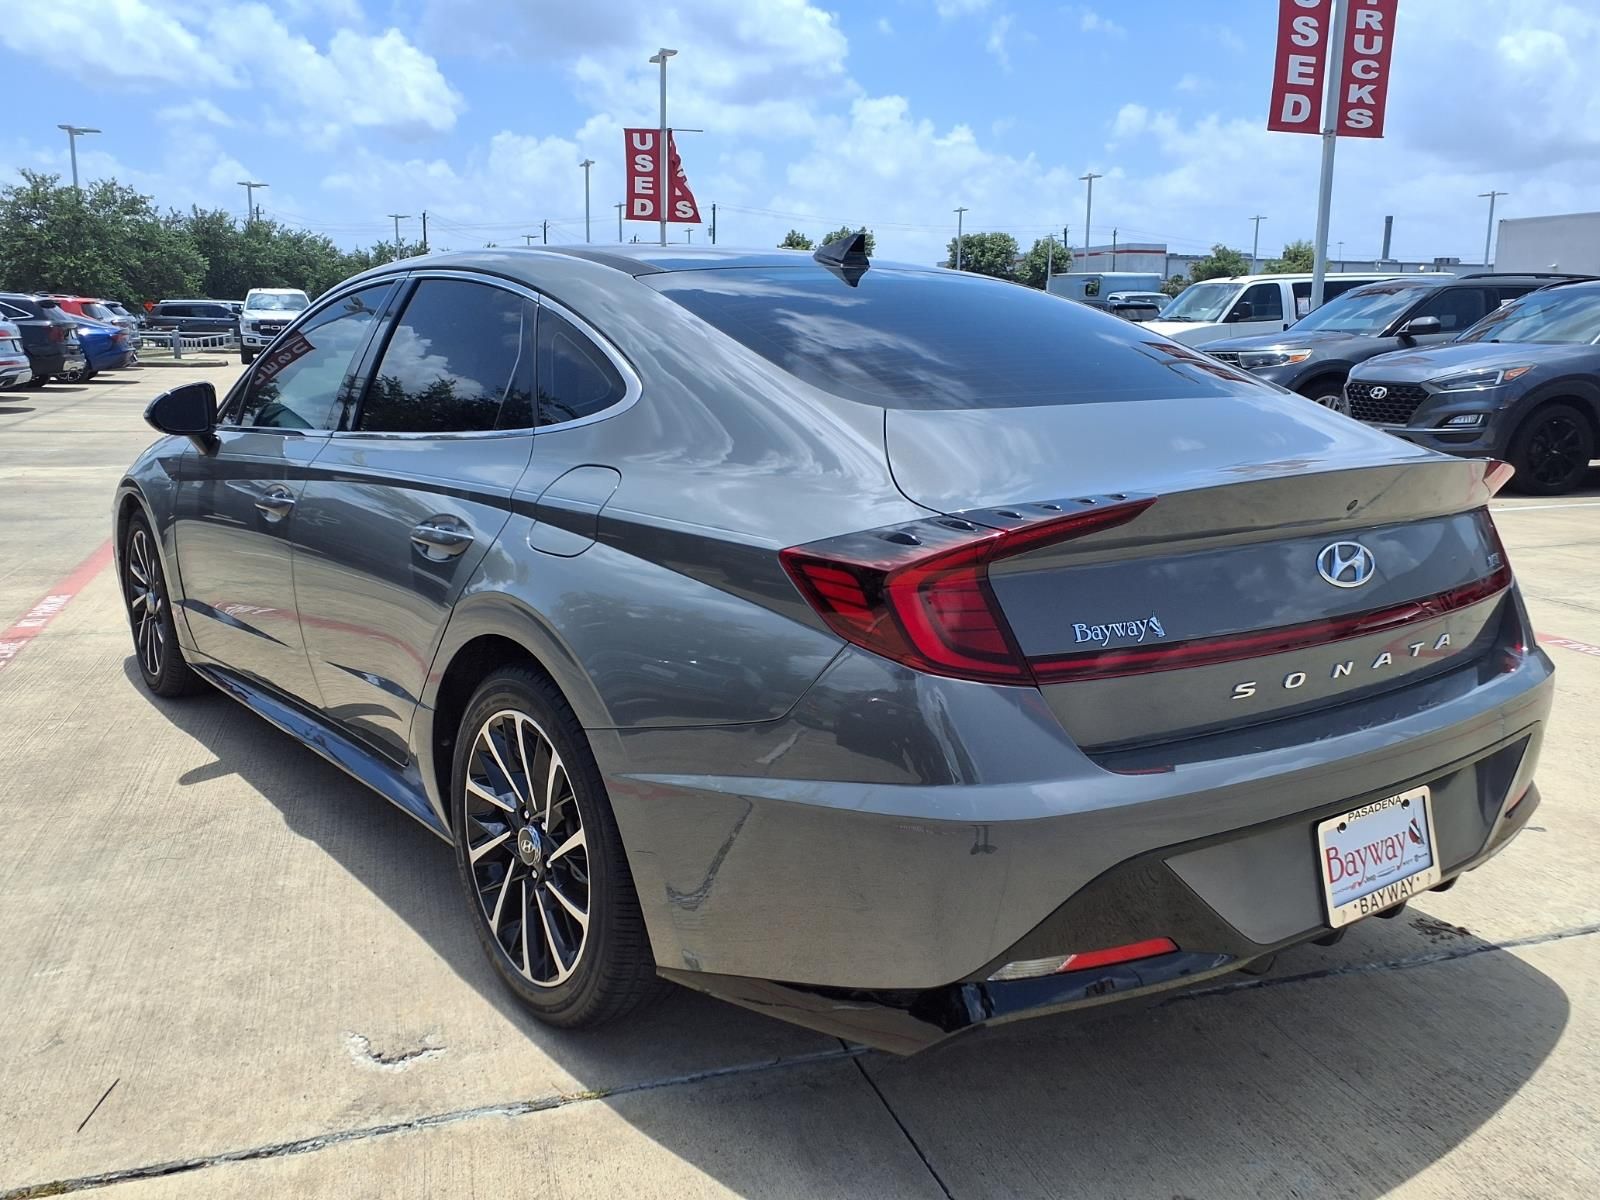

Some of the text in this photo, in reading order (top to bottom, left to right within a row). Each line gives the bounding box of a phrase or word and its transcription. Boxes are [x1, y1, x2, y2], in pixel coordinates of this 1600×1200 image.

[1281, 0, 1321, 123] SED
[1345, 0, 1383, 129] RUCKS
[632, 133, 655, 216] USED
[1072, 619, 1149, 647] Bayway
[1231, 632, 1451, 700] SONATA
[1347, 795, 1402, 823] PASADENA
[1325, 831, 1407, 887] Bayway
[1360, 875, 1415, 915] BAYWAY
